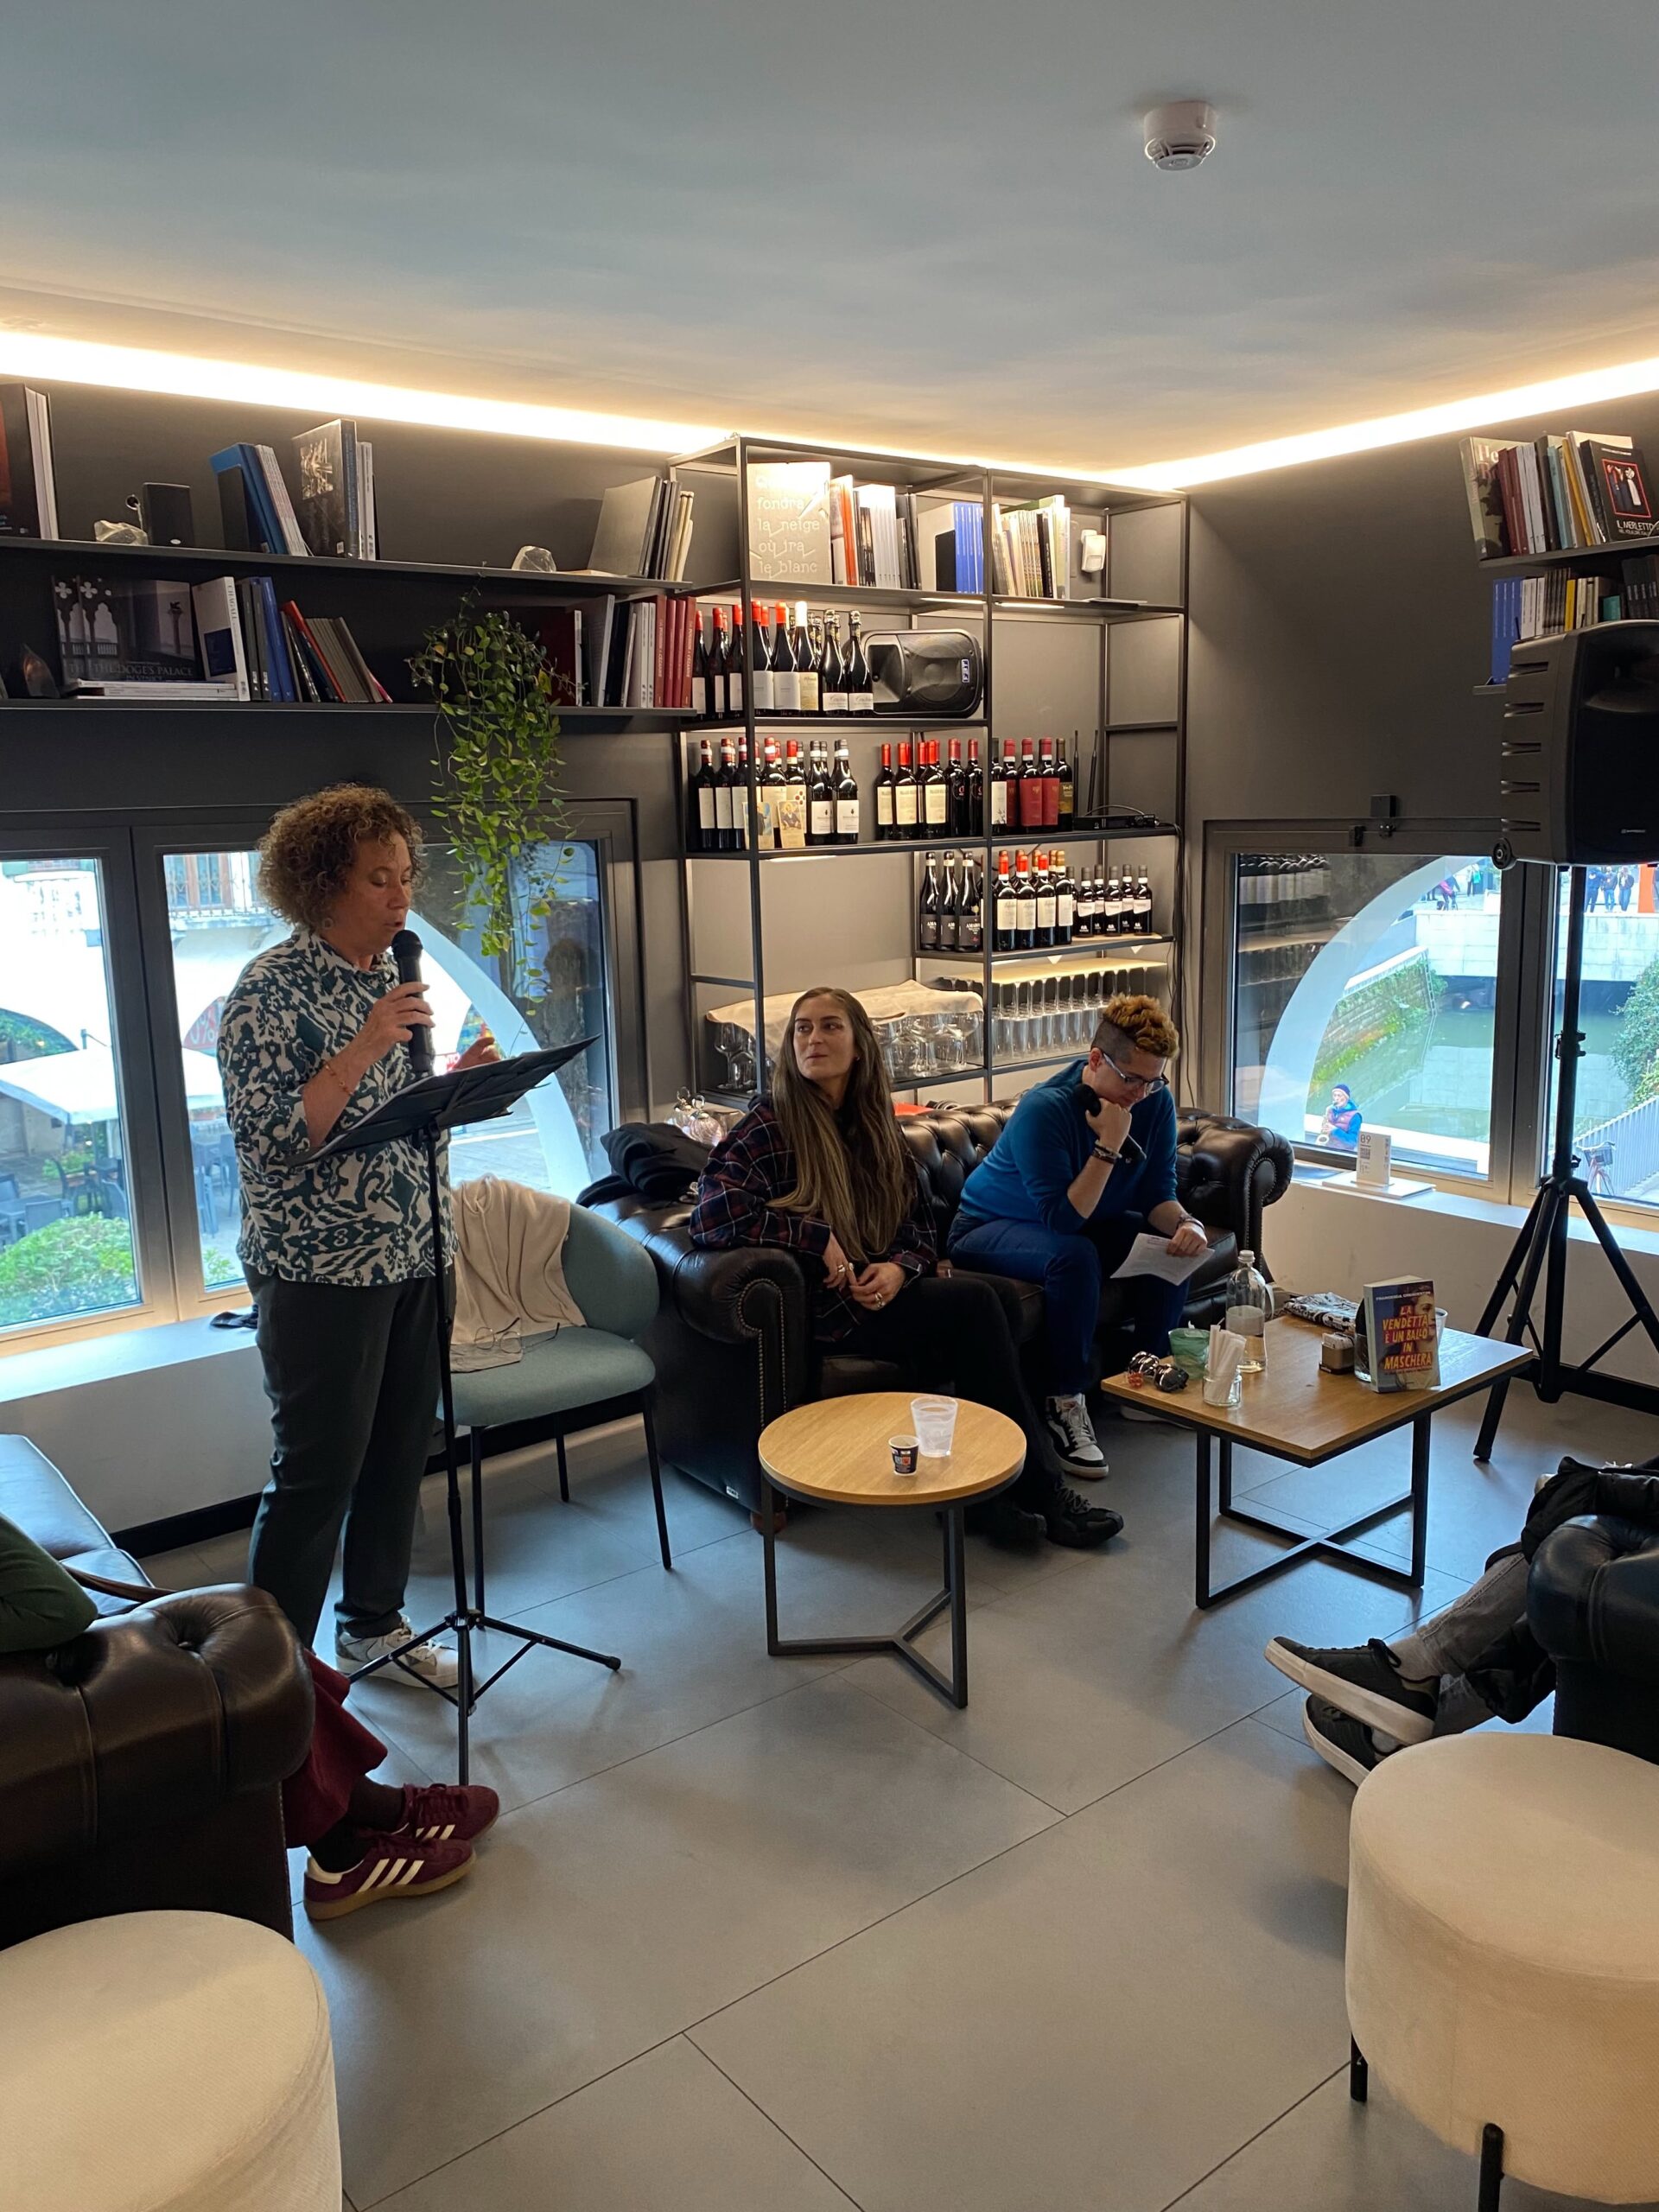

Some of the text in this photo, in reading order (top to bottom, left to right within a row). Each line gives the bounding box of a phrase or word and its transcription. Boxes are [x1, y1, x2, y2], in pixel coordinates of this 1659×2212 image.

[757, 496, 804, 510] fondra
[780, 518, 820, 532] neige
[780, 560, 817, 574] blanc
[227, 585, 238, 621] CHAGALL
[157, 665, 194, 677] PALACE
[1400, 1306, 1412, 1316] LA
[1382, 1315, 1428, 1331] VENDETTA
[1392, 1331, 1404, 1343] UN
[1406, 1328, 1427, 1341] BALLO
[1402, 1342, 1412, 1352] IN
[1384, 1352, 1432, 1370] MASCHERA
